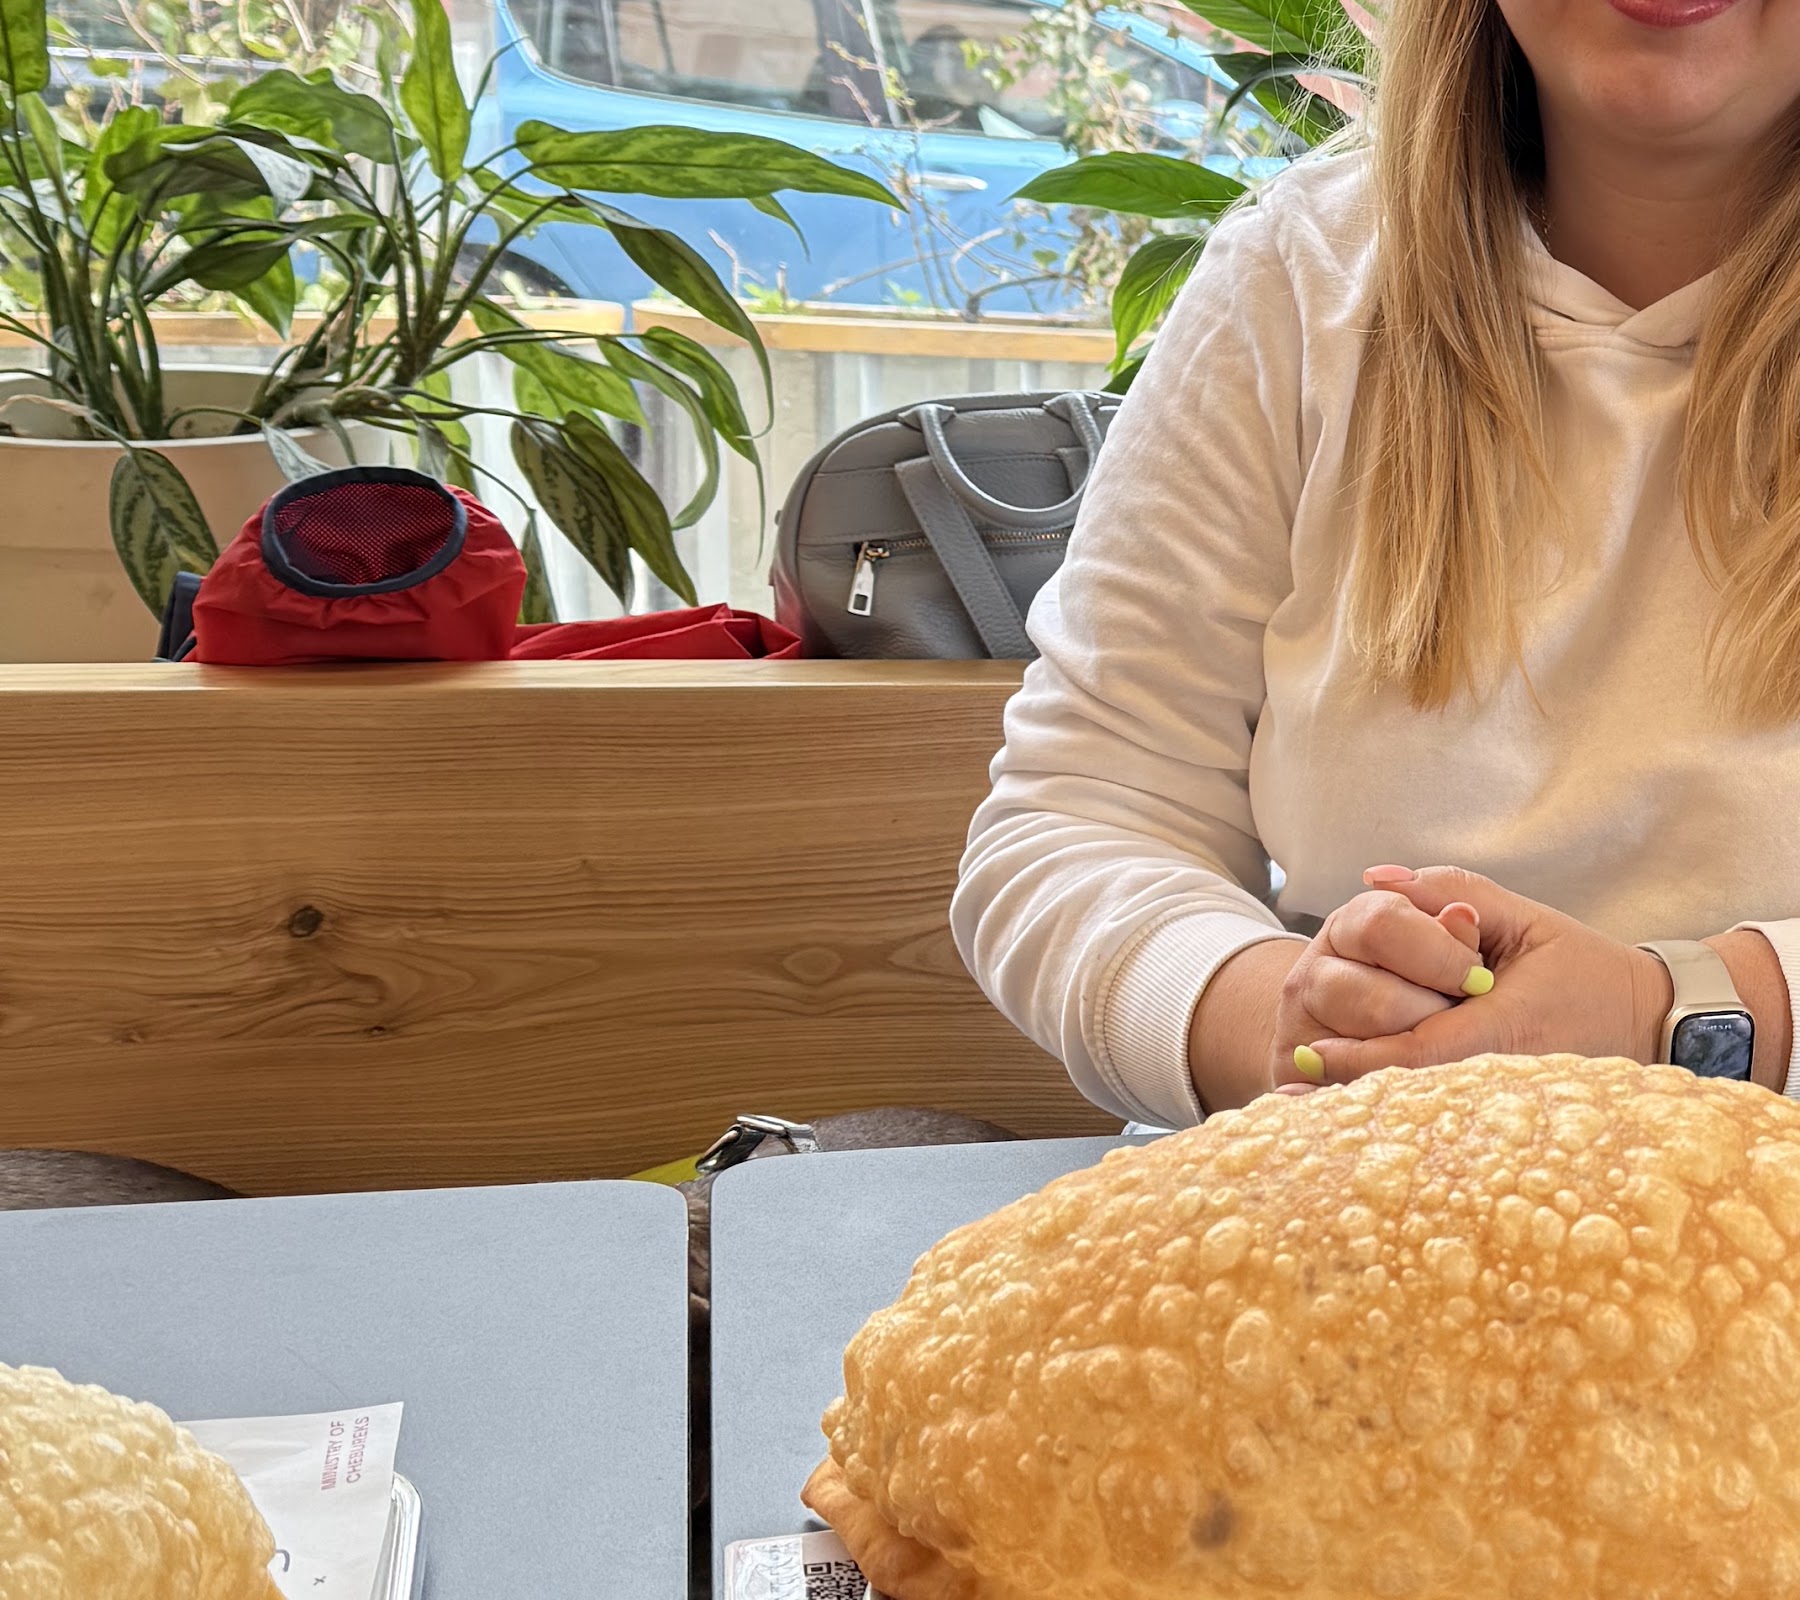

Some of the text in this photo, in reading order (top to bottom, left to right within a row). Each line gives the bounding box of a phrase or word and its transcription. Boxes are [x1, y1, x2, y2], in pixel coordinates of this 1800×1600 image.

[320, 1421, 345, 1491] MINISTRY OF
[346, 1416, 370, 1484] CHEBUREKS
